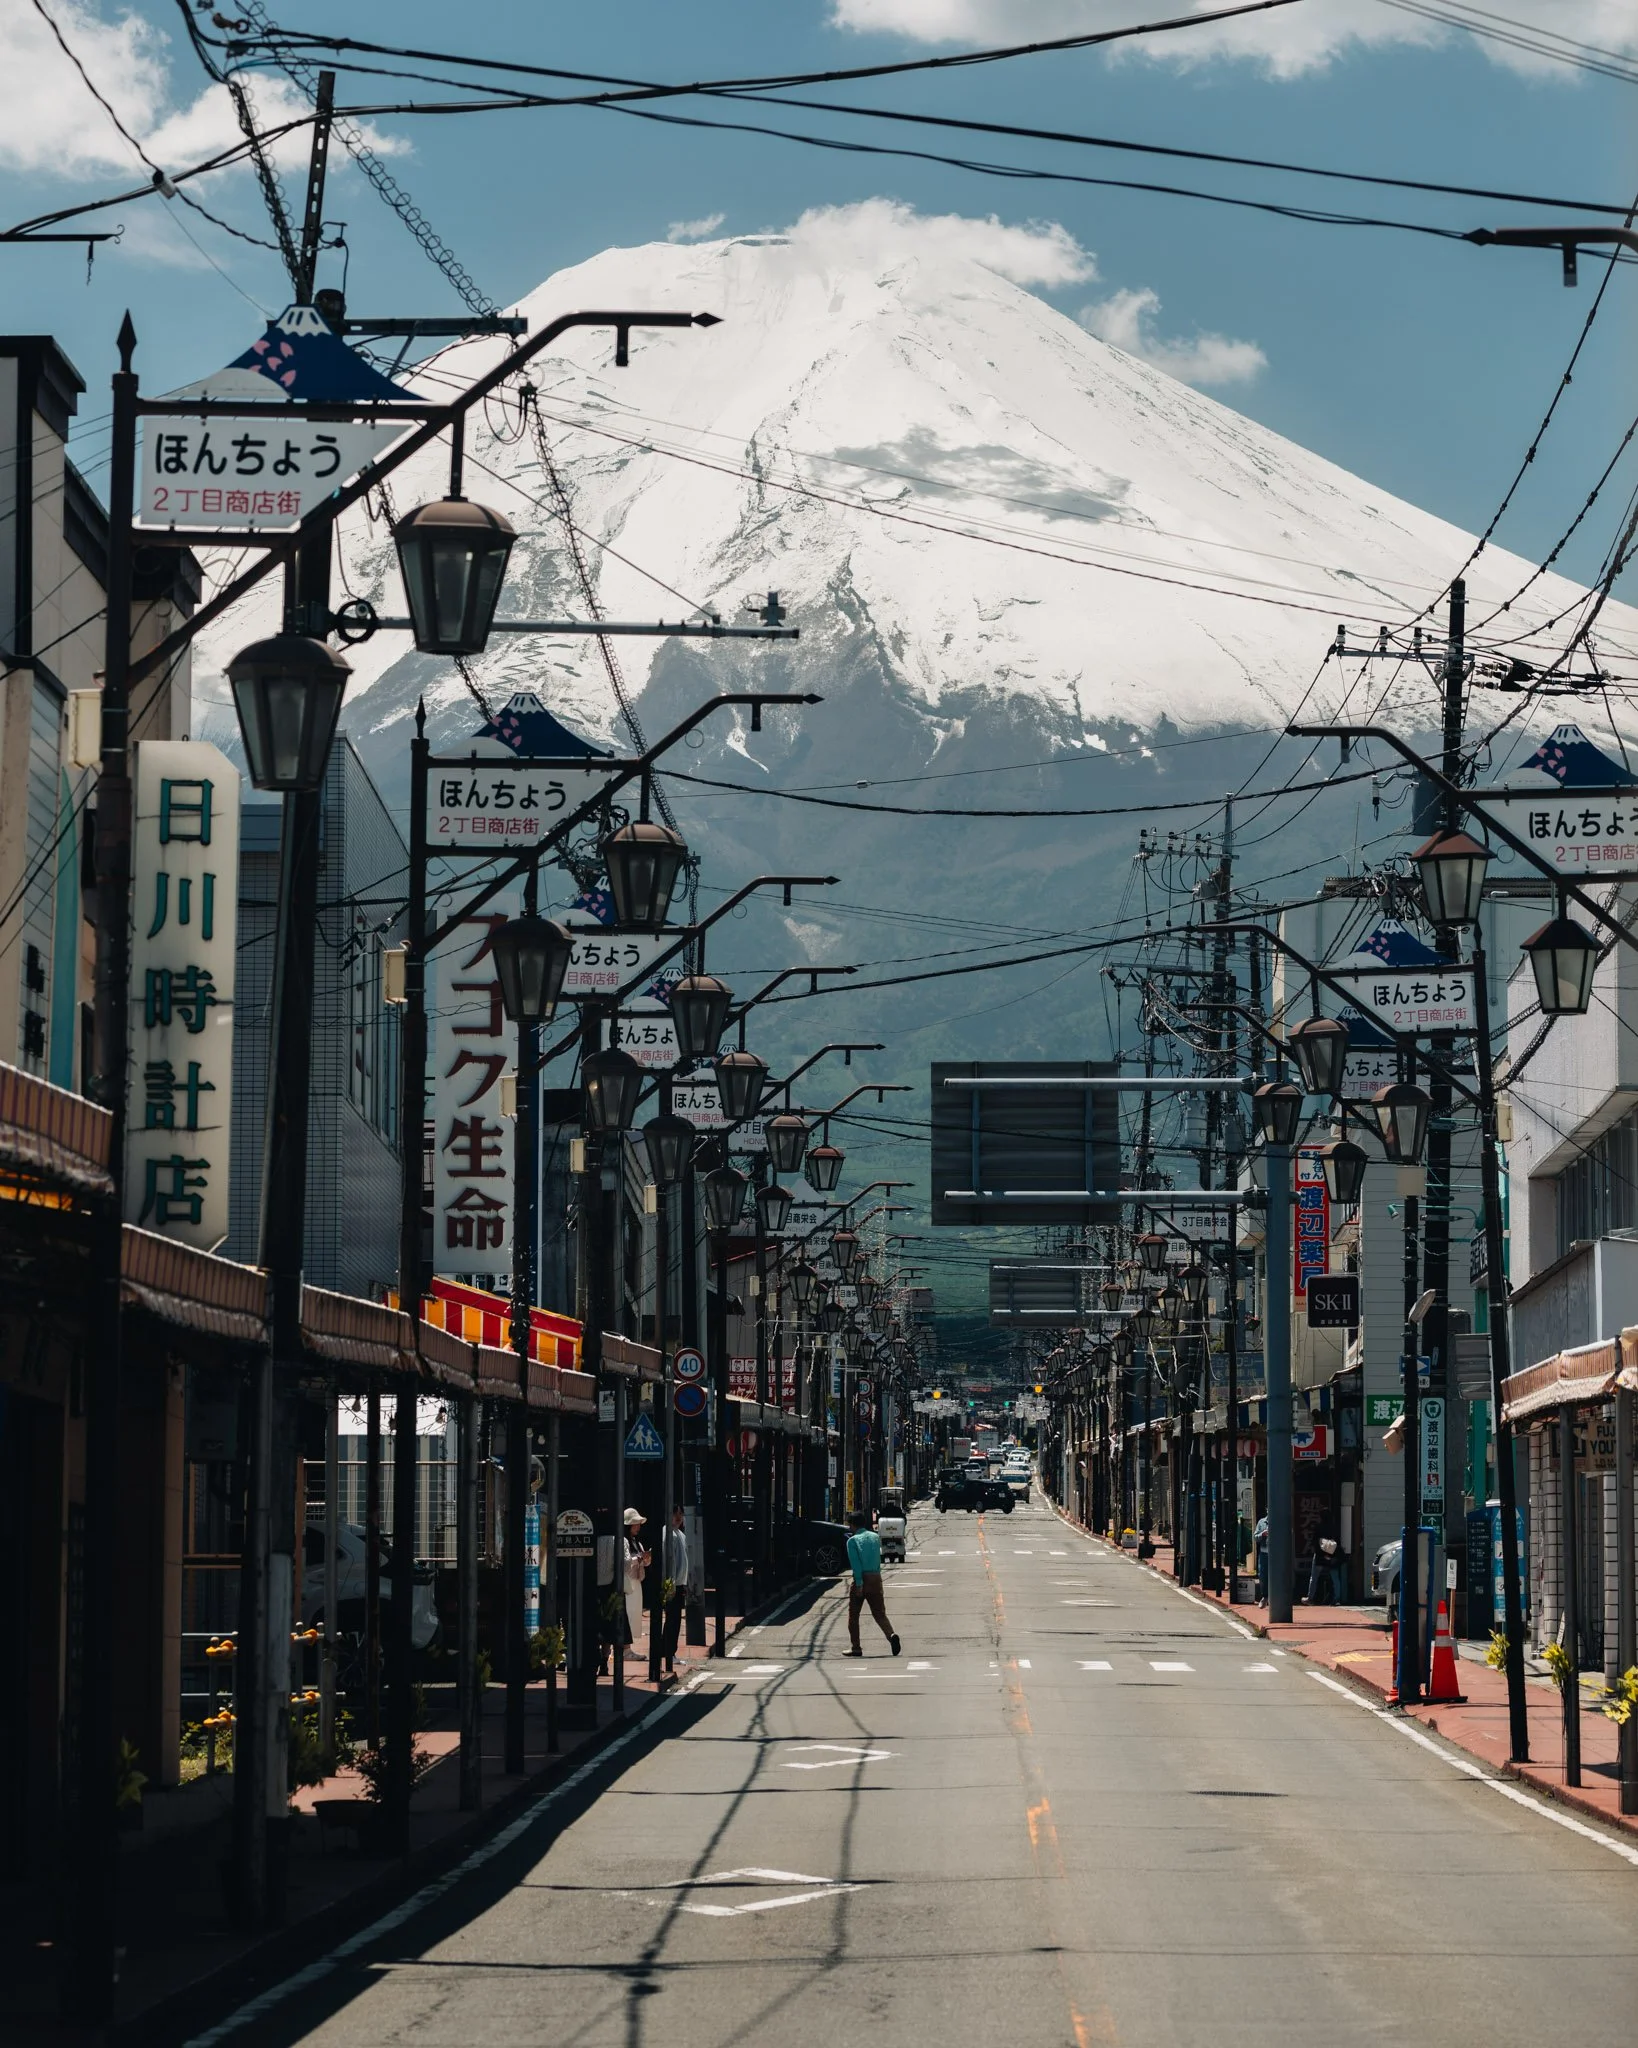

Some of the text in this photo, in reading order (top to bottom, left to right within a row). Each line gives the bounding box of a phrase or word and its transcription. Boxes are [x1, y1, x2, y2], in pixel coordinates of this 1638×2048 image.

[156, 432, 342, 479] ほんちょう
[153, 487, 301, 516] 2丁目商店街
[440, 778, 567, 811] ほんちょう
[439, 816, 539, 836] 2丁目商店街
[1556, 844, 1638, 862] 2丁目商店
[138, 778, 217, 1227] 日川時計店
[1374, 980, 1466, 1006] ほんちょう
[1394, 1007, 1467, 1024] 2丁目商店街
[442, 912, 508, 1251] フコク生命
[1182, 1216, 1227, 1228] 3丁目商栄会
[681, 1358, 698, 1373] 40
